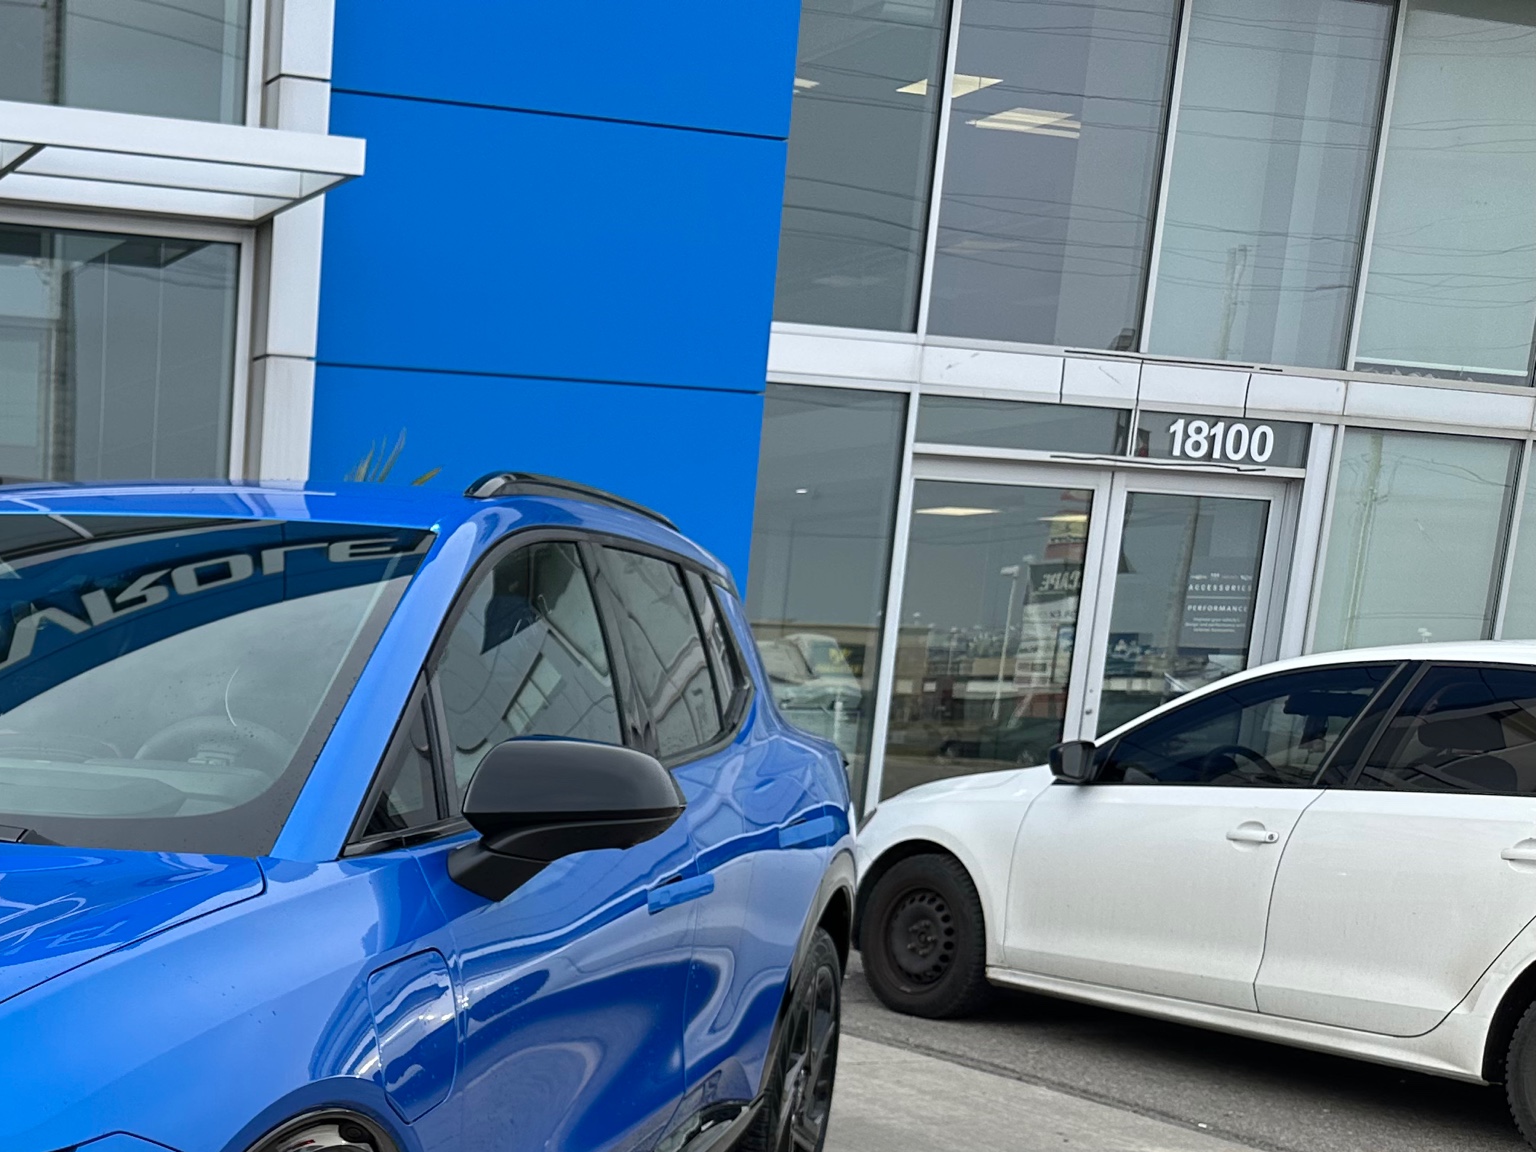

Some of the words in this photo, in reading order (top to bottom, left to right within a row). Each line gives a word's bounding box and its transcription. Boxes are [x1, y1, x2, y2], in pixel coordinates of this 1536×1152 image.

[1169, 418, 1274, 463] 18100
[1188, 583, 1252, 592] ACCESSORIES
[1187, 604, 1248, 612] PERFORMANCE
